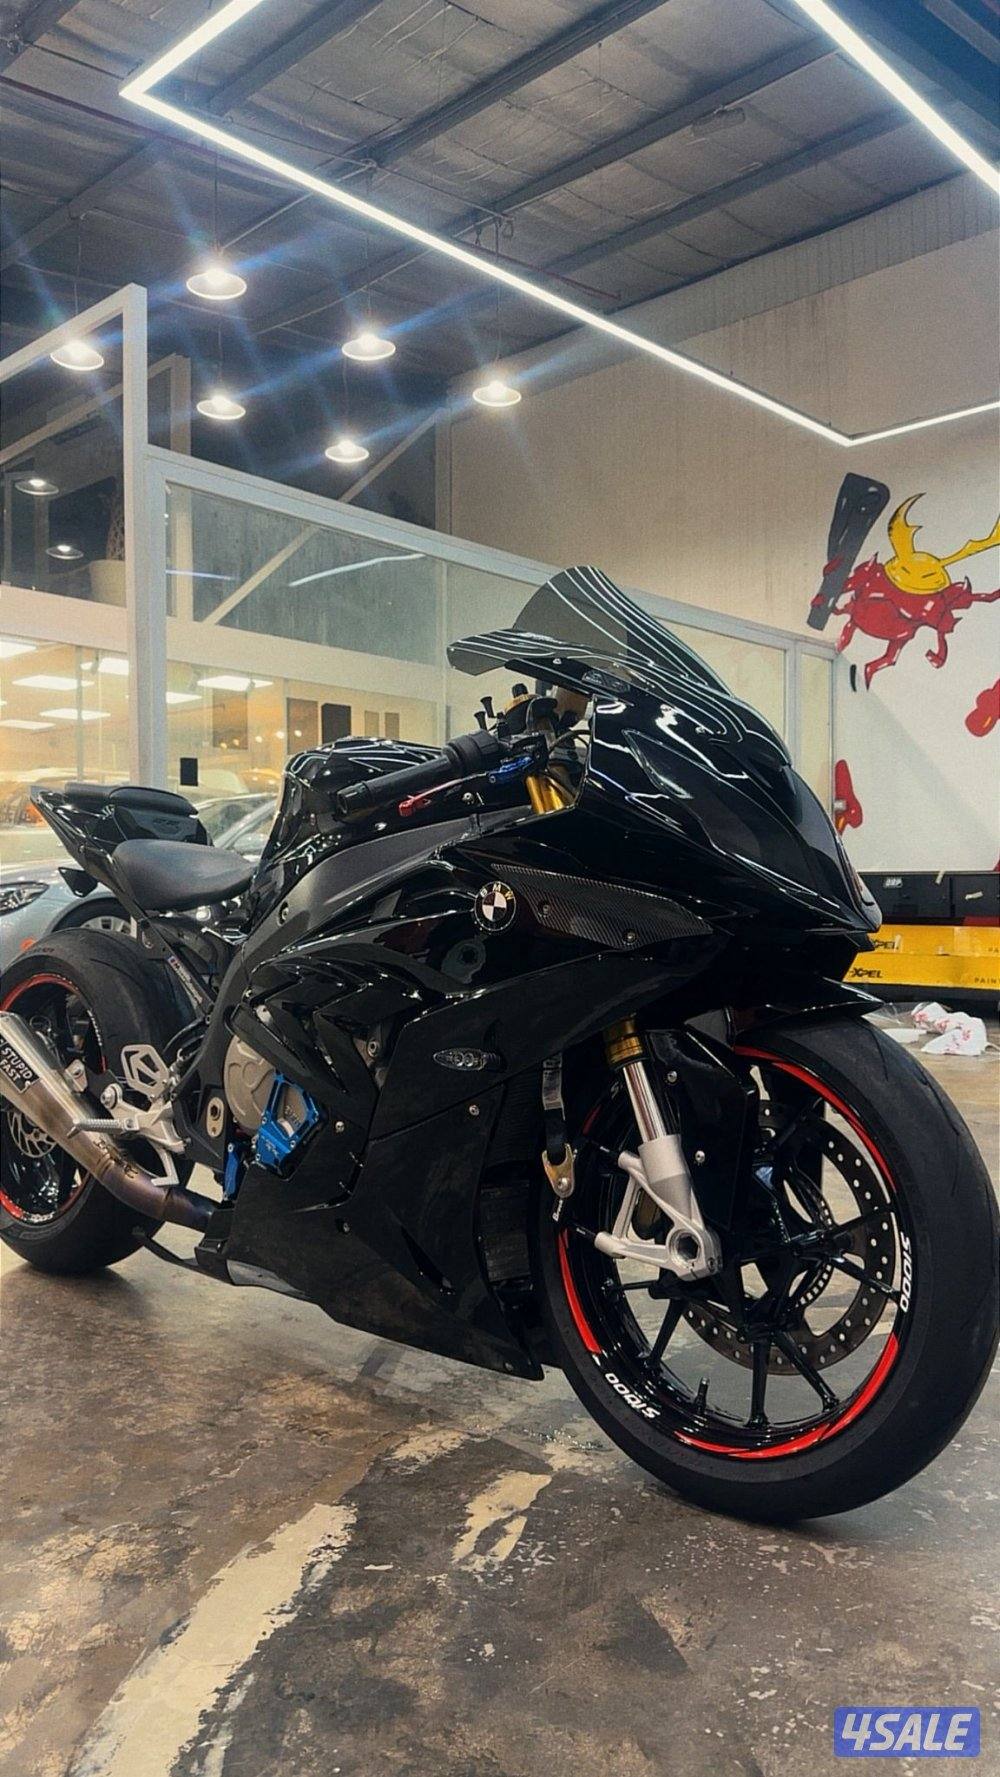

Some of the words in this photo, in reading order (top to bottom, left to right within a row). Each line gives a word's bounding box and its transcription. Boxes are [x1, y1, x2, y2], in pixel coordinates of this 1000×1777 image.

[480, 883, 514, 900] BMW
[974, 976, 1000, 984] PAIN
[0, 1047, 33, 1080] STUPID
[0, 1058, 21, 1081] FAST
[900, 1231, 912, 1313] S1000
[604, 1372, 661, 1419] S1000
